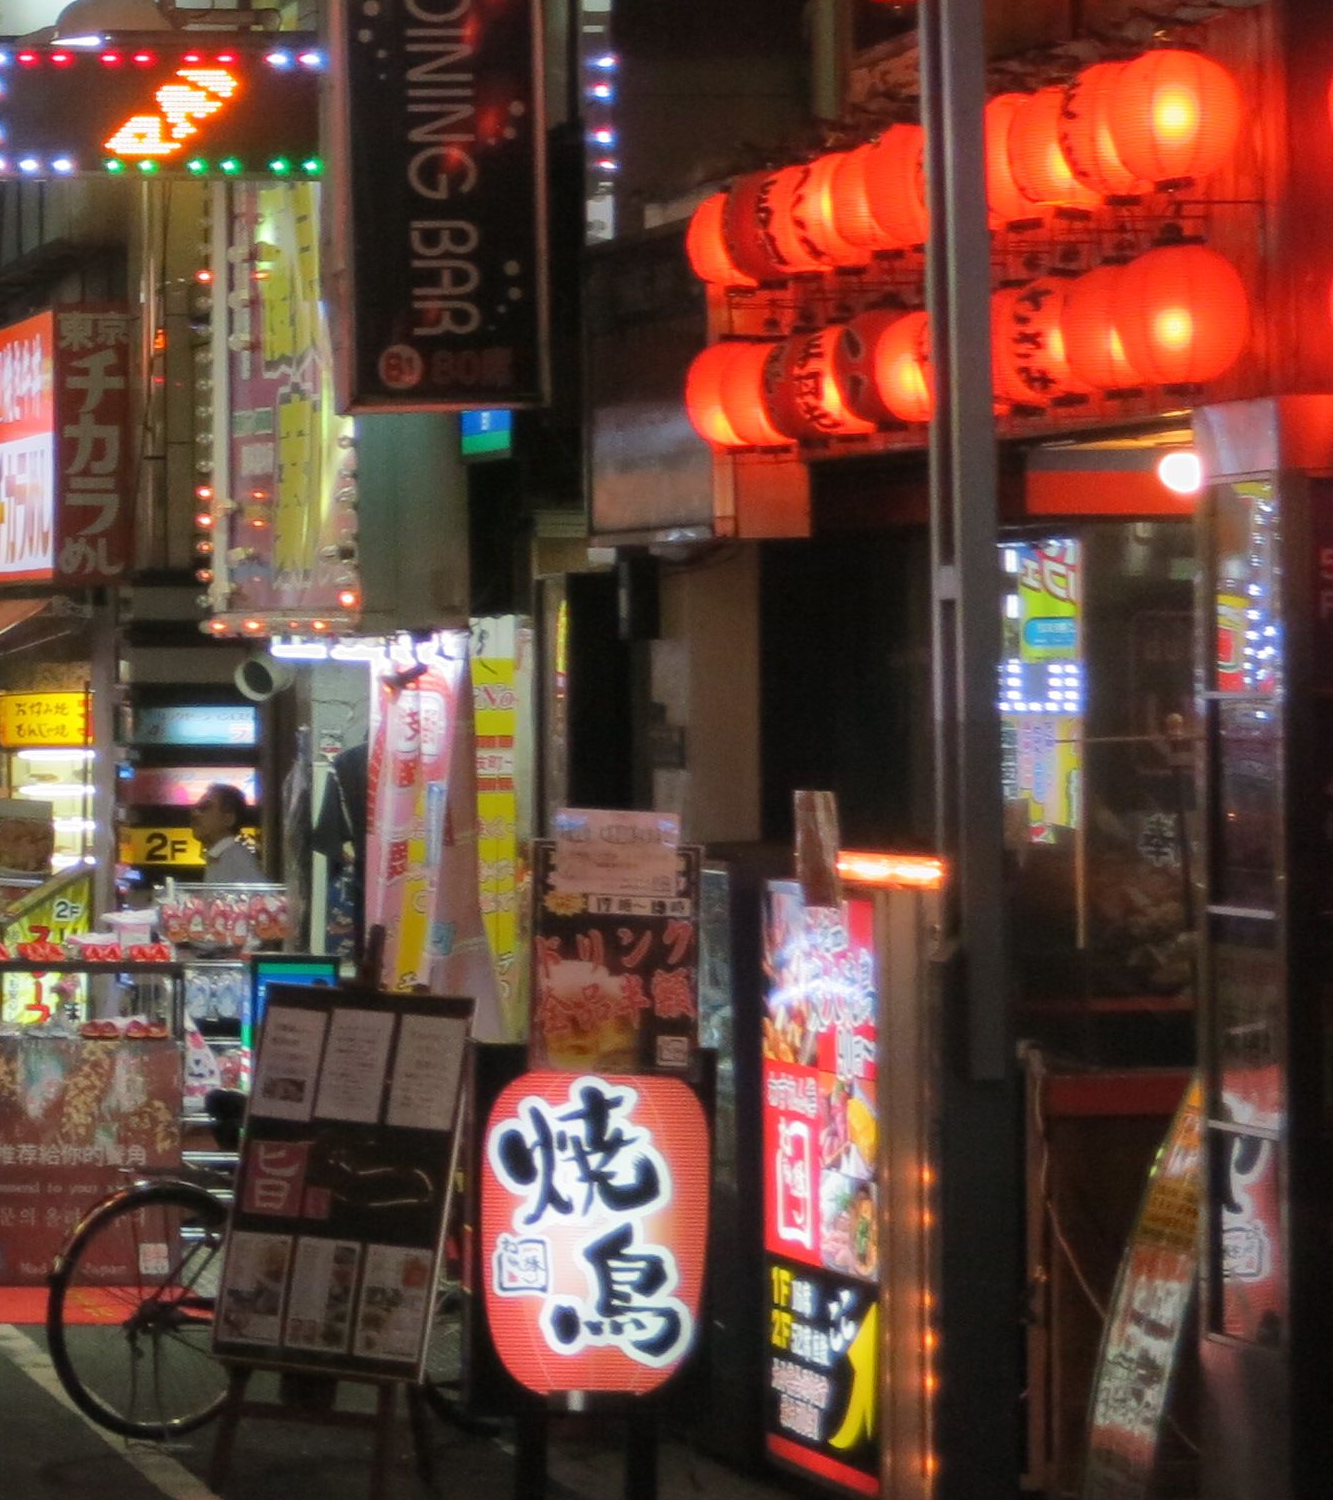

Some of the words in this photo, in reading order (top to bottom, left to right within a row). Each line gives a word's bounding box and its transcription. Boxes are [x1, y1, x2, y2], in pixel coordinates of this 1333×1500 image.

[410, 220, 481, 337] BAR
[57, 311, 130, 351] 東京
[64, 350, 127, 537] チカラ
[59, 537, 126, 576] めし
[145, 832, 189, 863] 2F
[54, 900, 81, 920] 2F
[495, 1083, 683, 1358] 焼鳥
